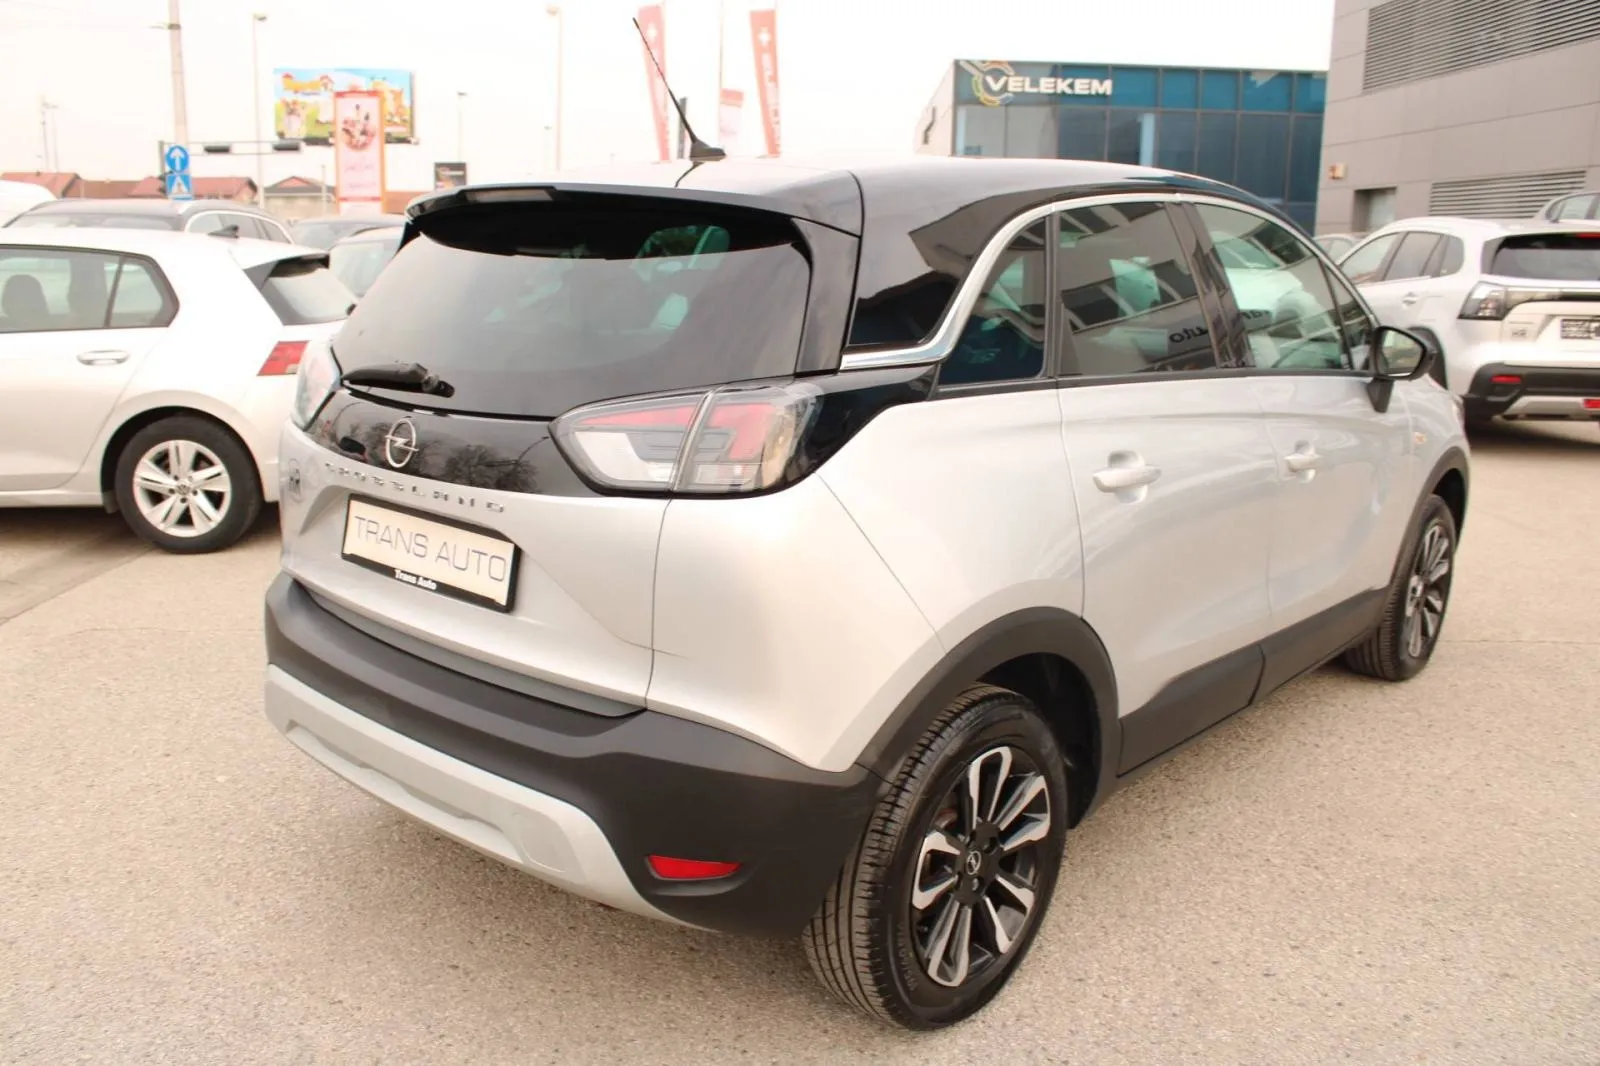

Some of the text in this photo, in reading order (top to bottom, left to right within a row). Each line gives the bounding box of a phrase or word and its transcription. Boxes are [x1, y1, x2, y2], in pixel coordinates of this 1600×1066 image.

[985, 75, 1113, 96] VELEKEM
[354, 515, 507, 583] TRANS AUTO
